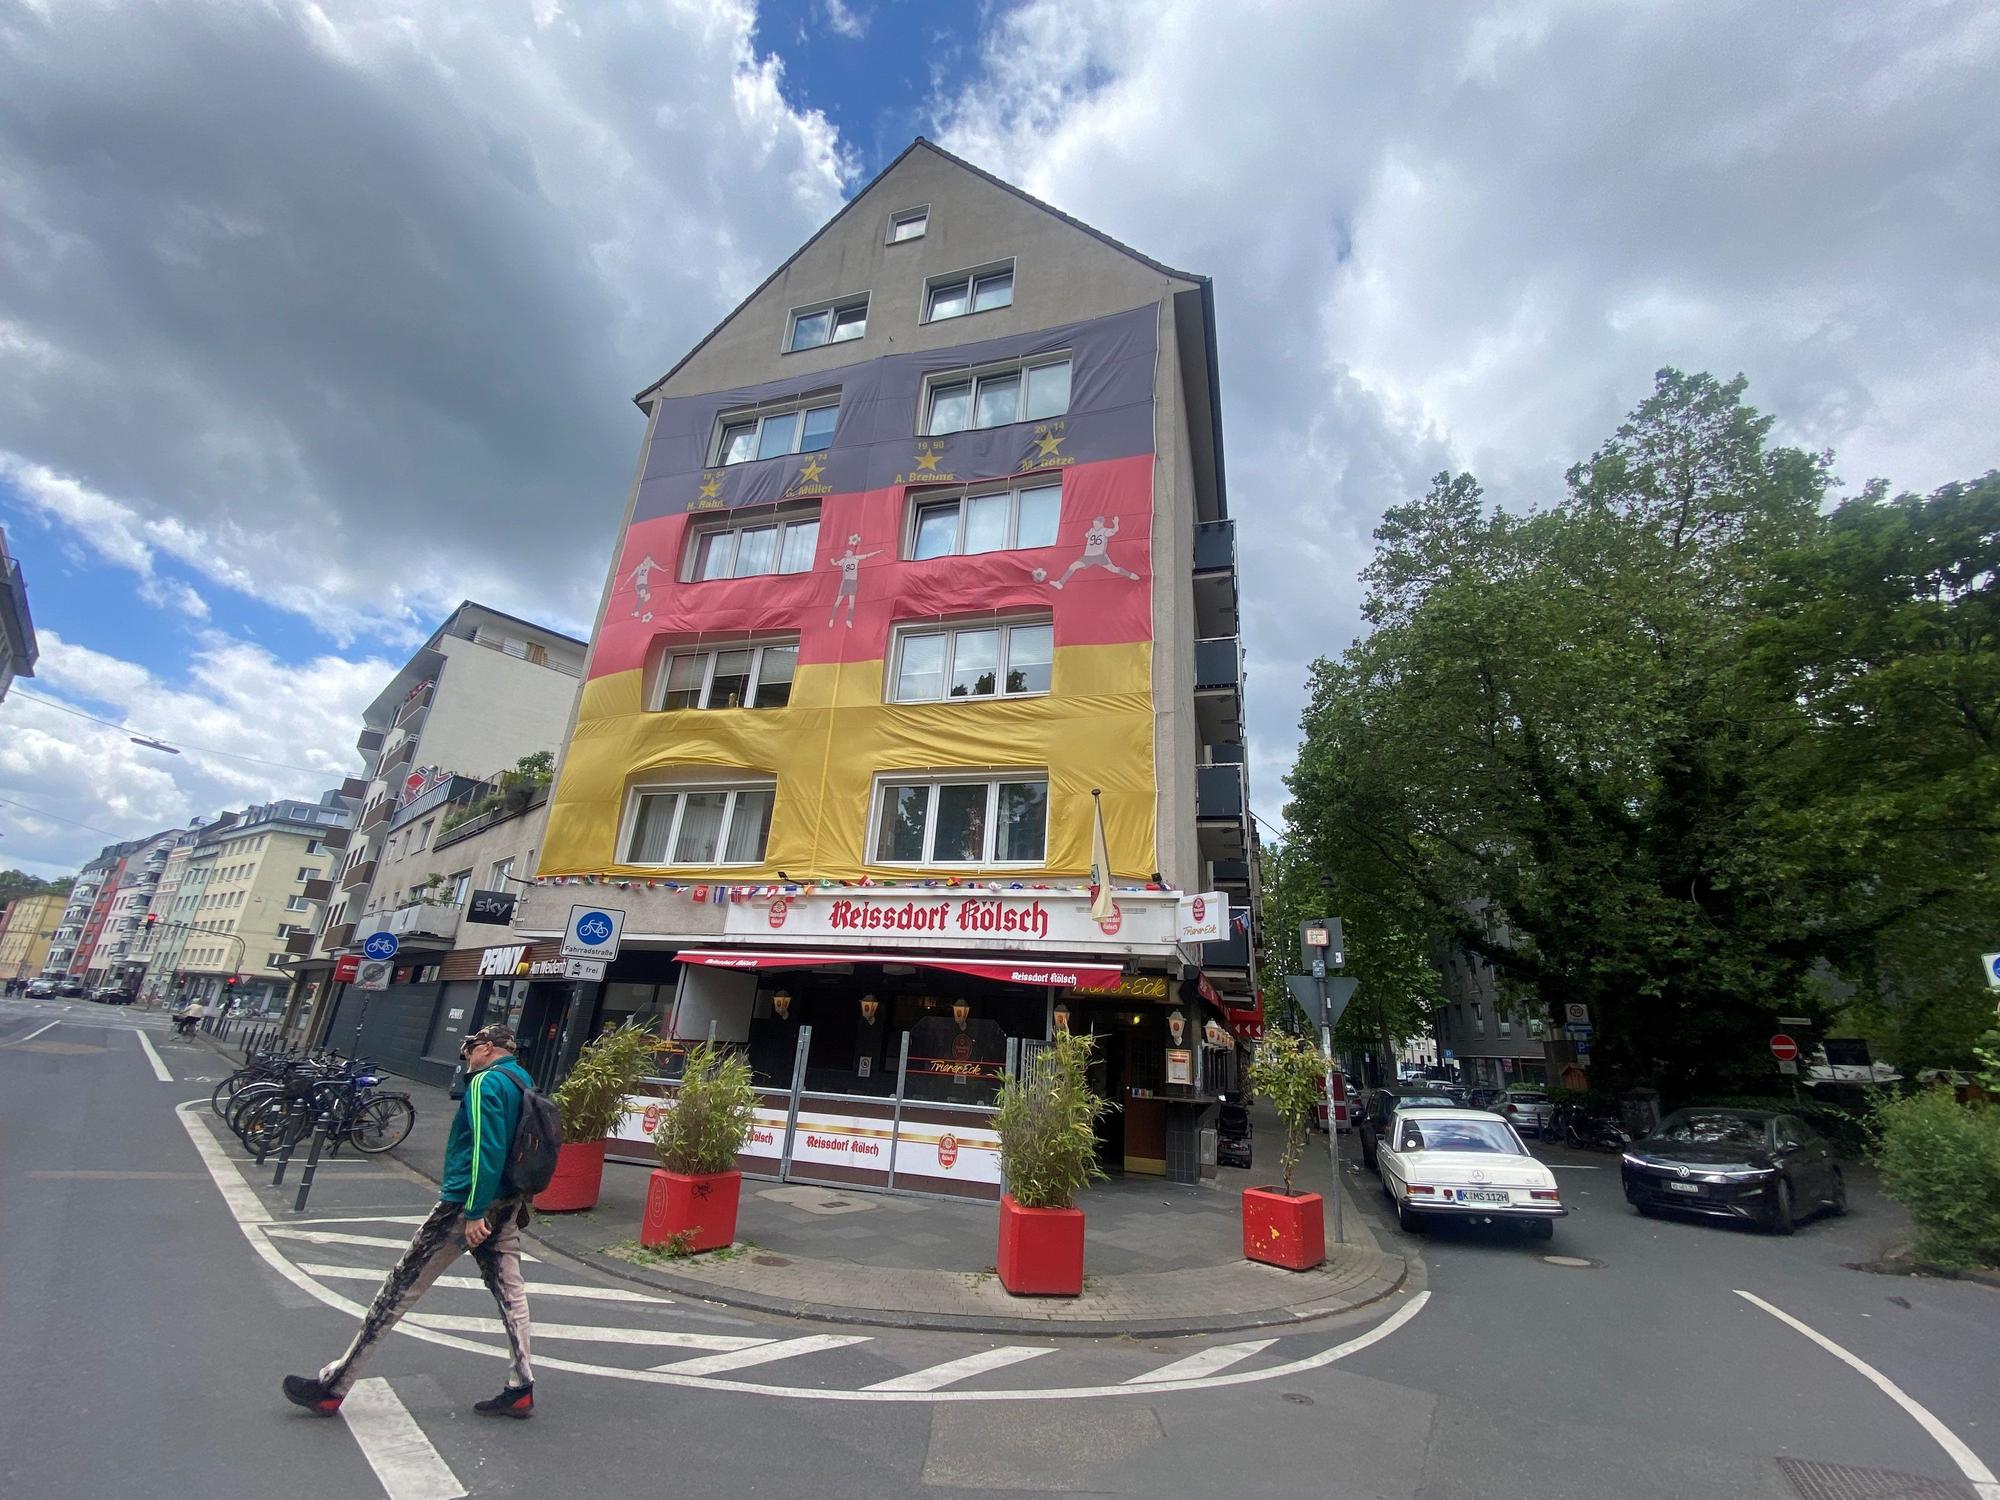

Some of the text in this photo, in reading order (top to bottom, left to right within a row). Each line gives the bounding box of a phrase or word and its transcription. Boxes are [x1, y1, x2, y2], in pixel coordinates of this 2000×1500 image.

[933, 440, 944, 449] 90
[894, 474, 906, 484] A.
[1090, 534, 1103, 546] 96
[474, 897, 510, 917] sky
[828, 898, 1049, 940] Reissdorf Kölsch
[564, 945, 614, 957] Fahrradstraße
[585, 966, 599, 975] frei
[1010, 971, 1077, 986] Reissdorf Kölsch
[805, 1135, 880, 1158] Reissdorf Kölsch
